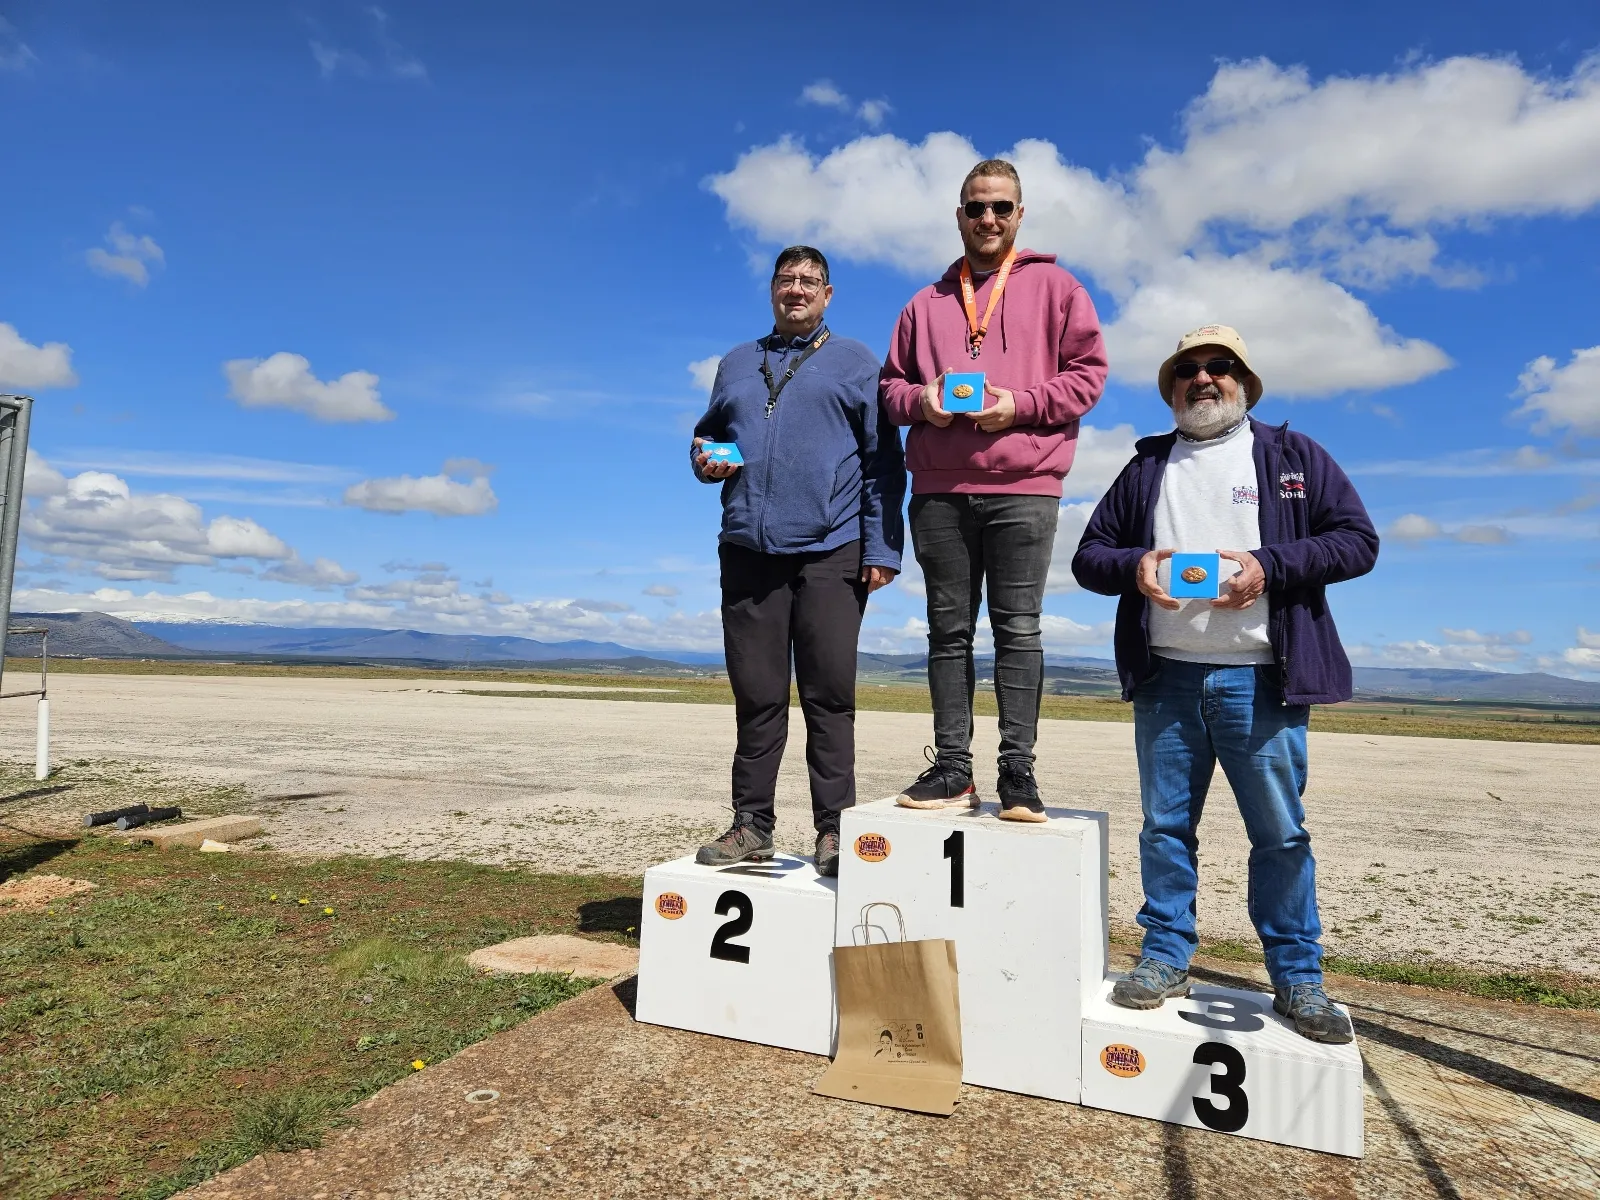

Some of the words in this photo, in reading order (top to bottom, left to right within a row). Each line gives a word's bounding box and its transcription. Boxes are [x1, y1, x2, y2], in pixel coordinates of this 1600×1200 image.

[858, 835, 886, 844] CLUB
[943, 830, 965, 908] 1
[659, 894, 683, 902] CLUB
[658, 907, 684, 915] SORIA
[710, 889, 754, 965] 2
[1105, 1046, 1138, 1056] CLUB
[1105, 1061, 1142, 1073] SORIA
[1192, 1041, 1250, 1133] 3
